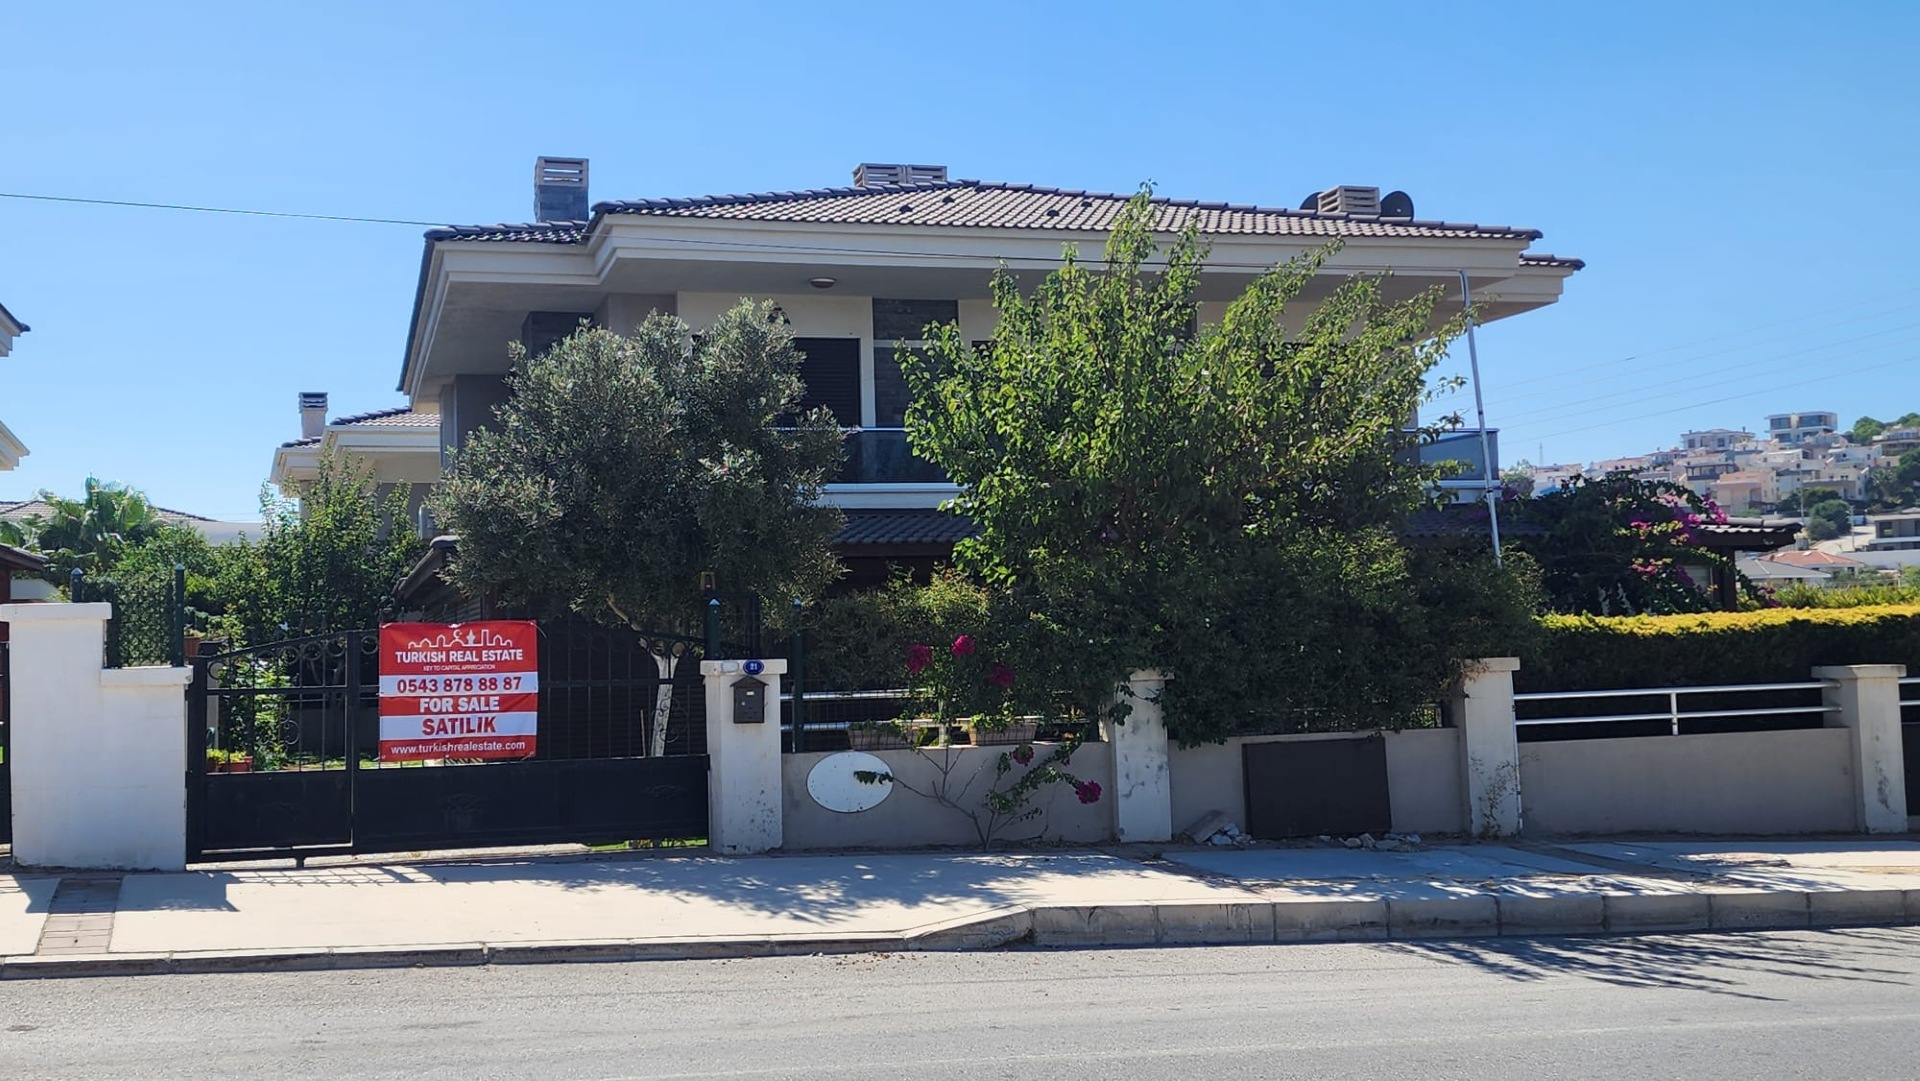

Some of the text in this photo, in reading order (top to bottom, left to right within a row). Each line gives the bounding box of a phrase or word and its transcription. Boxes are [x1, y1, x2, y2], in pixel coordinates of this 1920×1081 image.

[395, 649, 523, 663] TURKISH REAL ESTATE
[397, 676, 522, 694] 0543 878 88 87
[419, 696, 500, 713] FOR SALE
[422, 716, 496, 736] SATILIK
[390, 741, 526, 755] www.turkishrealestate.com
